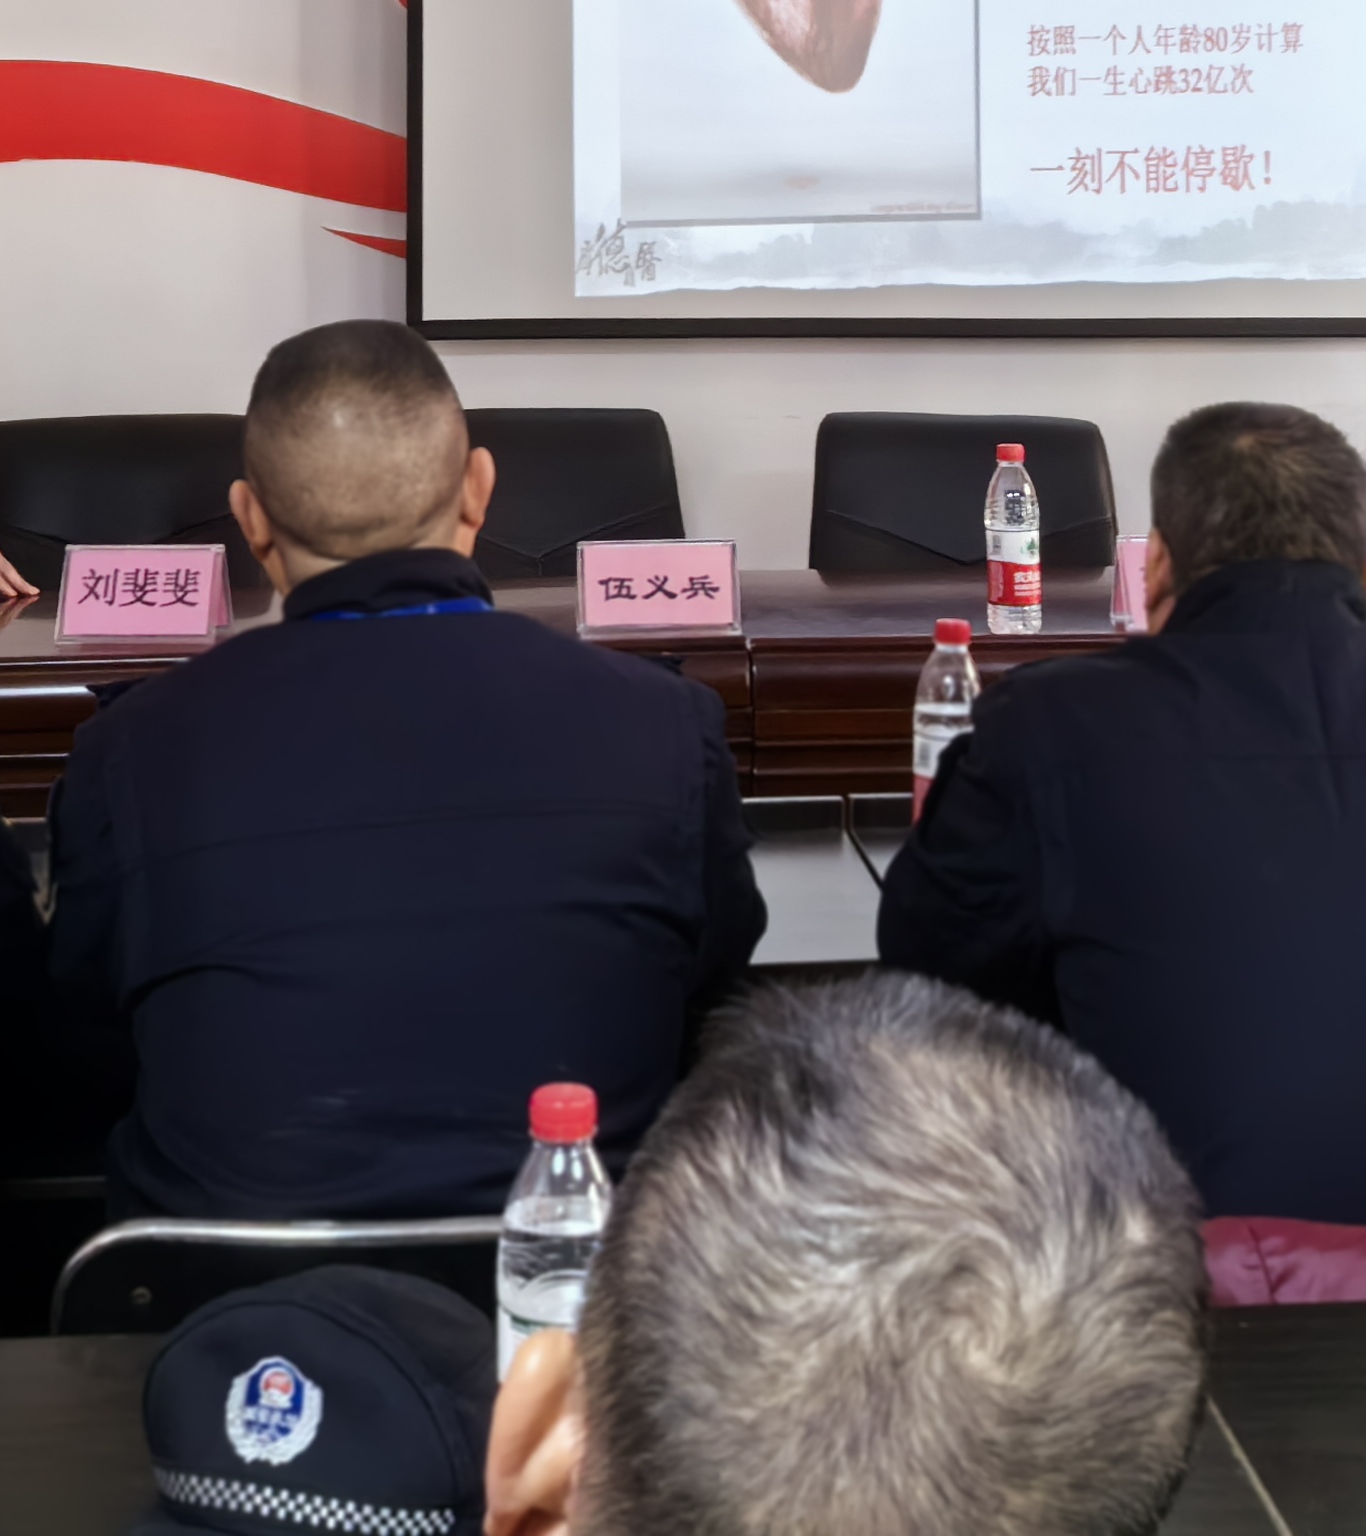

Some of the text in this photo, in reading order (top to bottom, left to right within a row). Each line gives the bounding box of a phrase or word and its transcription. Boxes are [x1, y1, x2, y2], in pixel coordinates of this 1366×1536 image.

[1027, 22, 1304, 56] 按照一个人年龄80岁计算
[1027, 63, 1255, 96] 我们一生心跳32亿次
[77, 568, 202, 608] 刘斐斐
[597, 574, 721, 602] 伍义兵
